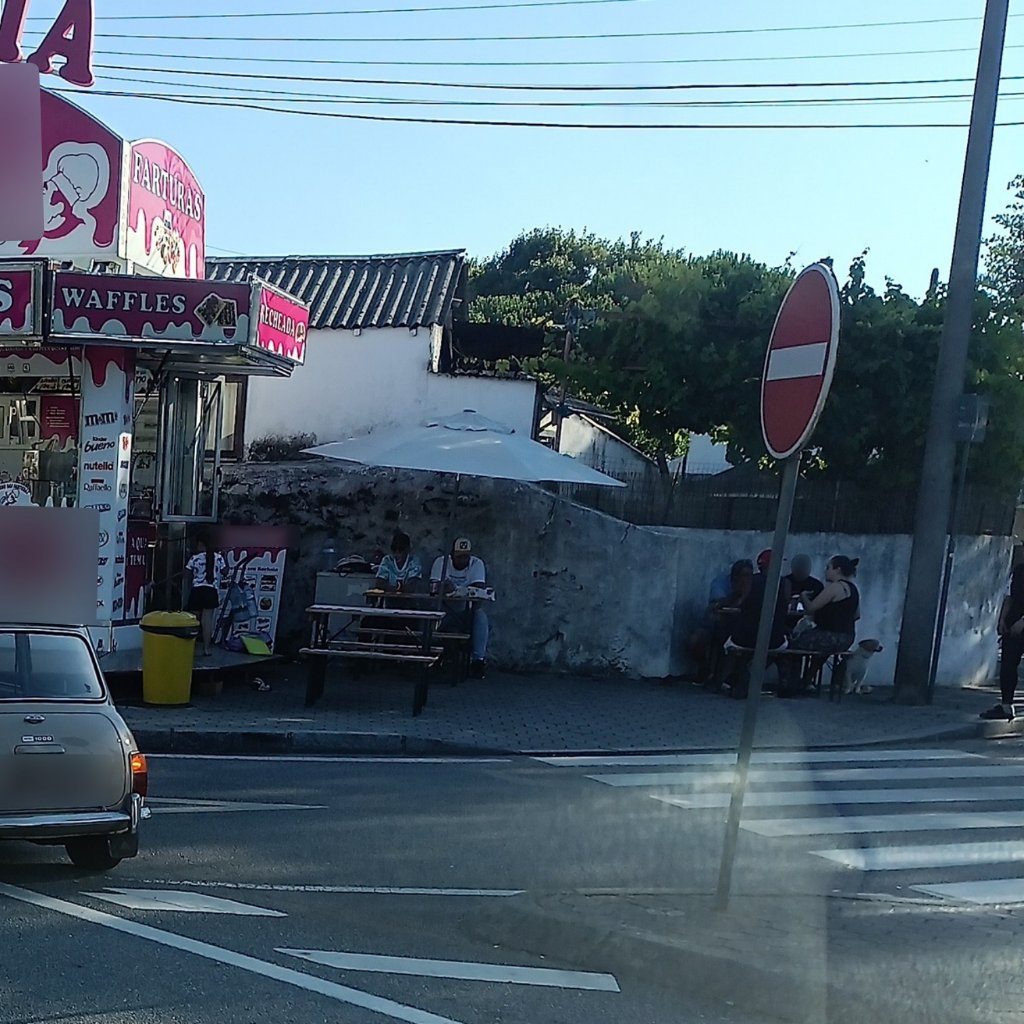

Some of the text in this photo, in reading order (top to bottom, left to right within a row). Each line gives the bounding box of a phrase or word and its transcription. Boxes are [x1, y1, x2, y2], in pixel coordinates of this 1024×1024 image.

[133, 151, 201, 221] FARTURAS
[61, 287, 186, 313] WAFFLES
[259, 303, 295, 337] RECHEADA
[84, 440, 116, 452] bueno
[83, 461, 114, 470] nutella
